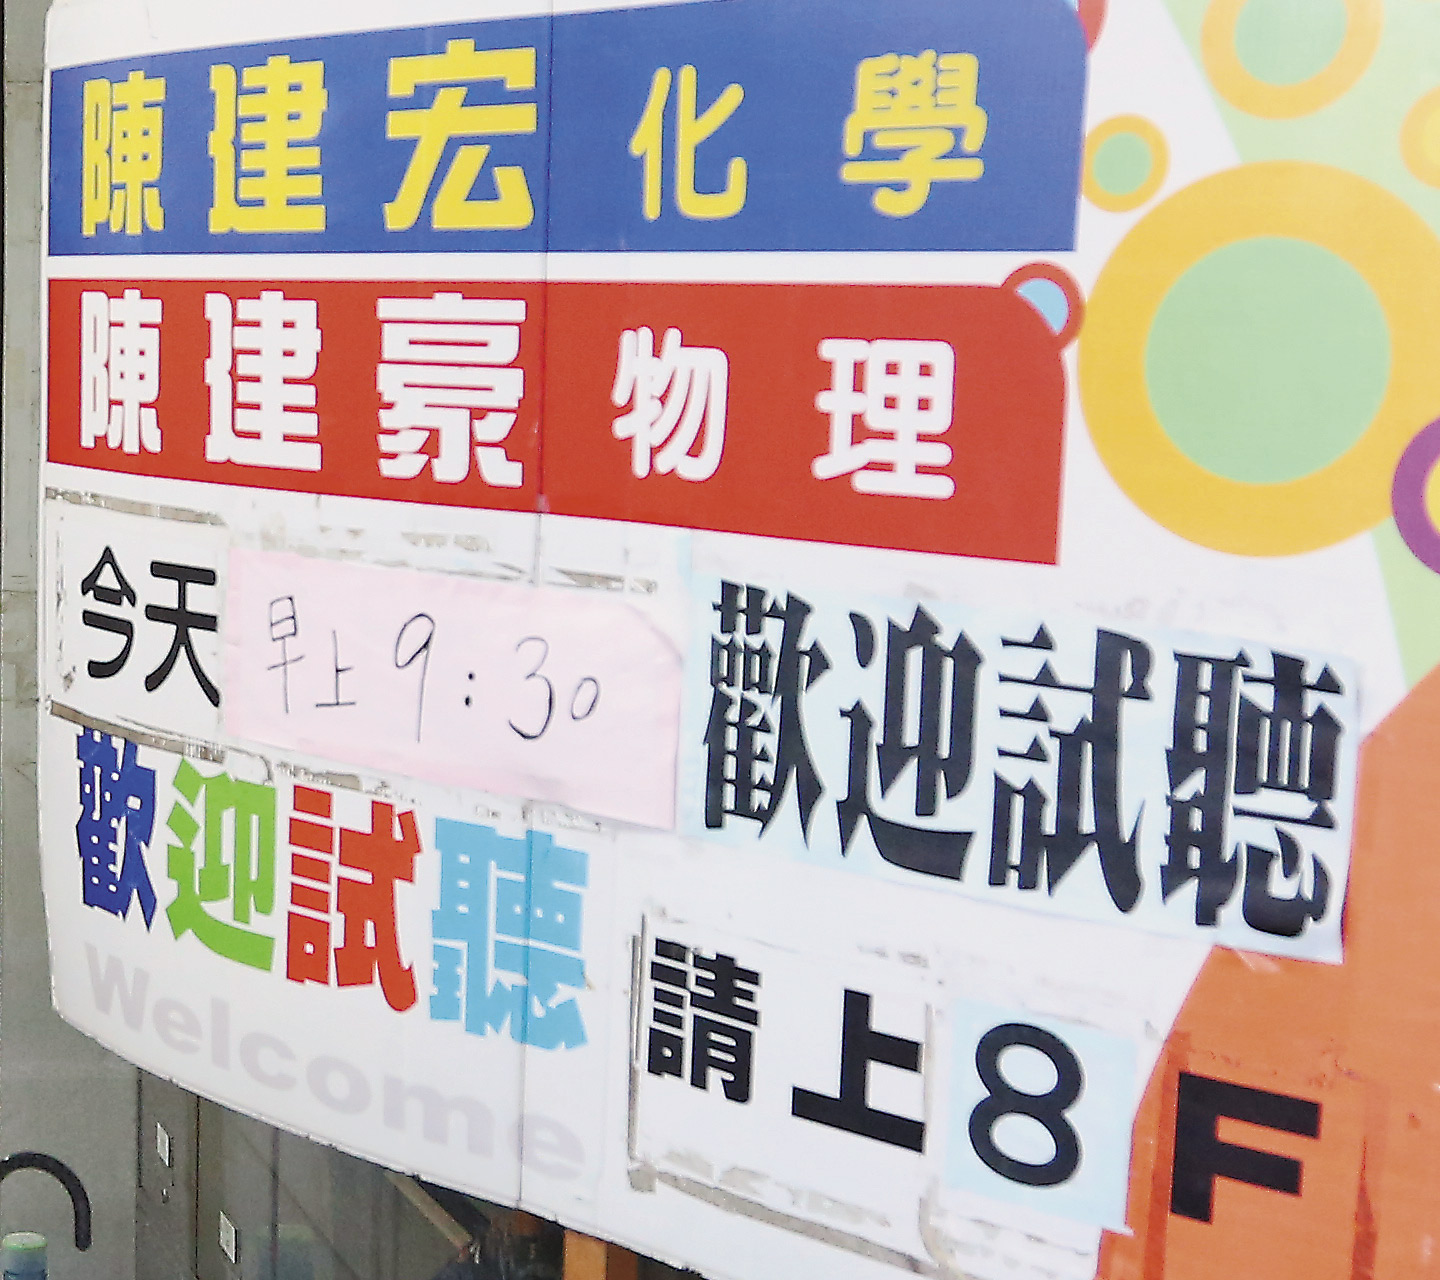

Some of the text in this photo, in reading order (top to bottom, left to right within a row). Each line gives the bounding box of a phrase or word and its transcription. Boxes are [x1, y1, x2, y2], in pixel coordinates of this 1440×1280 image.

[80, 37, 992, 236] 陳建宏化學
[77, 290, 958, 501] 陳建豪物理
[79, 544, 221, 708] 今天
[701, 578, 1347, 942] 歡迎試聽
[74, 724, 591, 1052] 歡迎試聽
[84, 940, 587, 1180] Welcome
